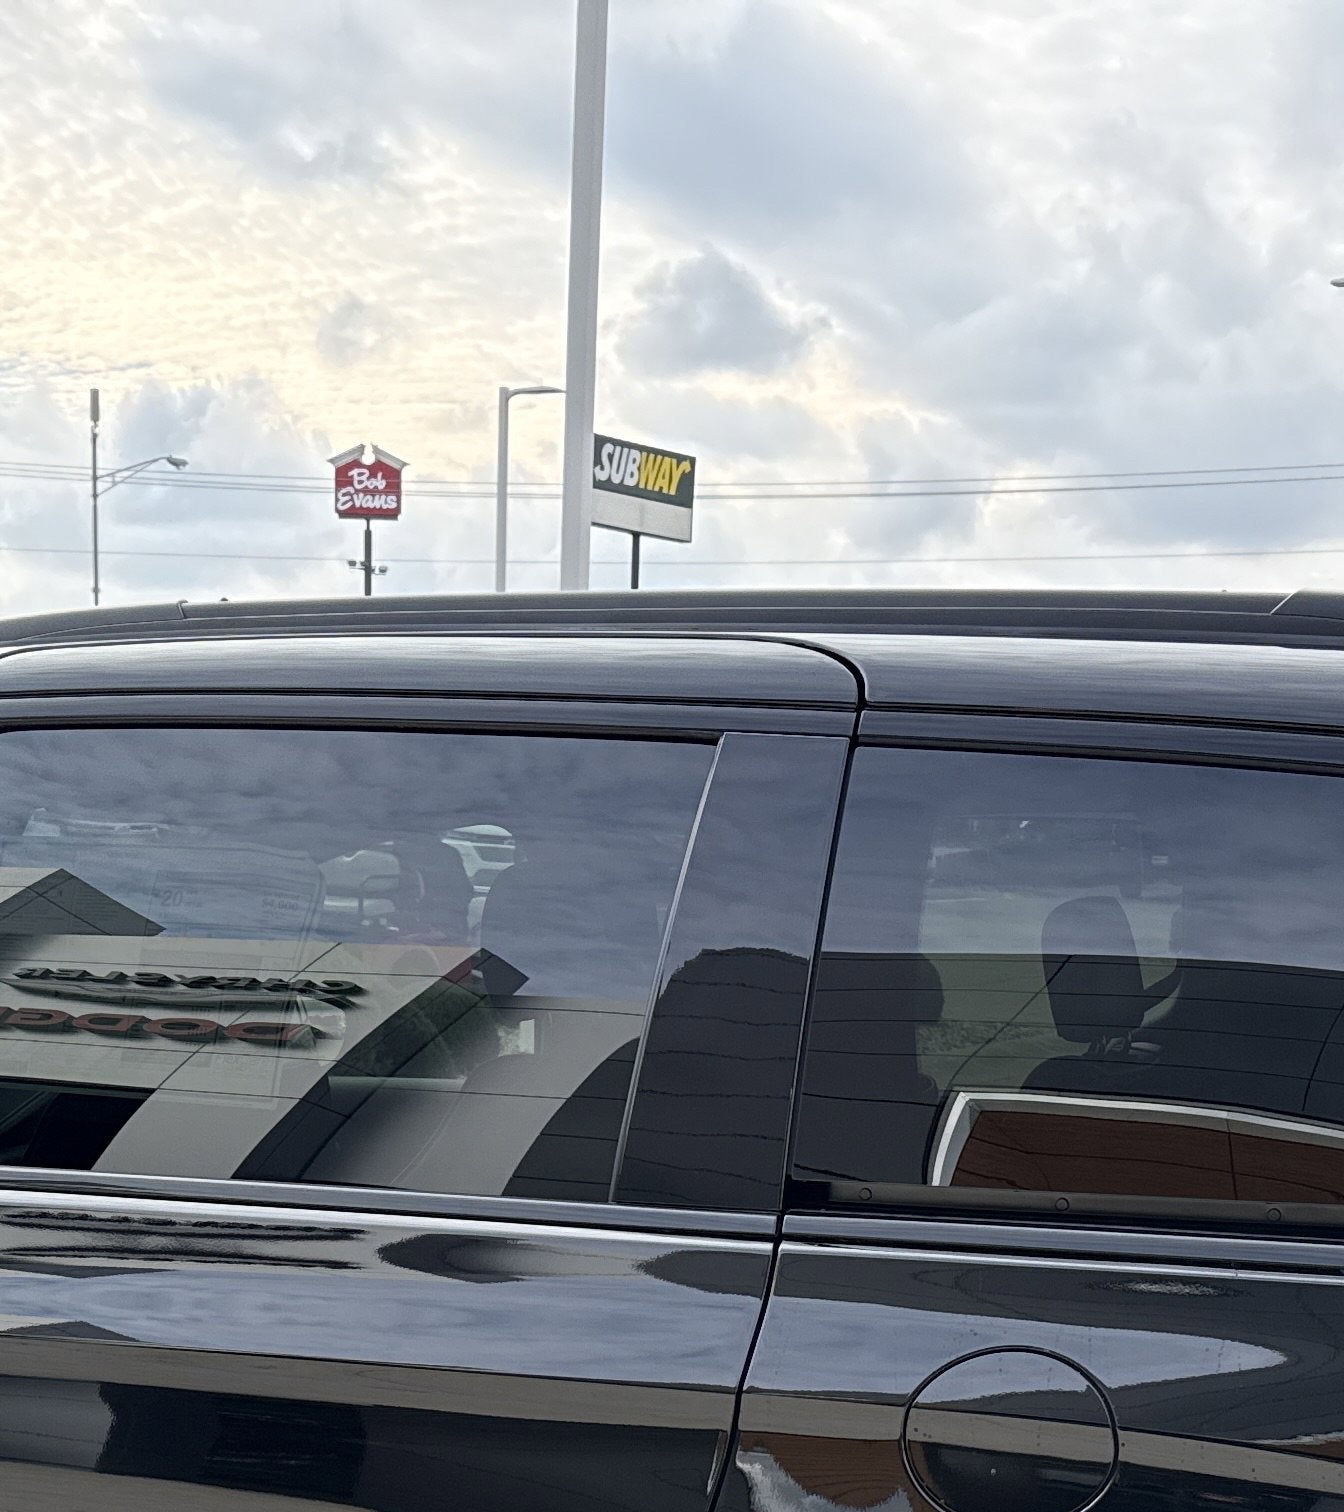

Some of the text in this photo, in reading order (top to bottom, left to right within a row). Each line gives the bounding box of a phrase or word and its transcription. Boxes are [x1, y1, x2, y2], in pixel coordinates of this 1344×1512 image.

[347, 467, 387, 490] Bob
[593, 442, 692, 496] SUBWAY
[336, 486, 398, 511] Evans
